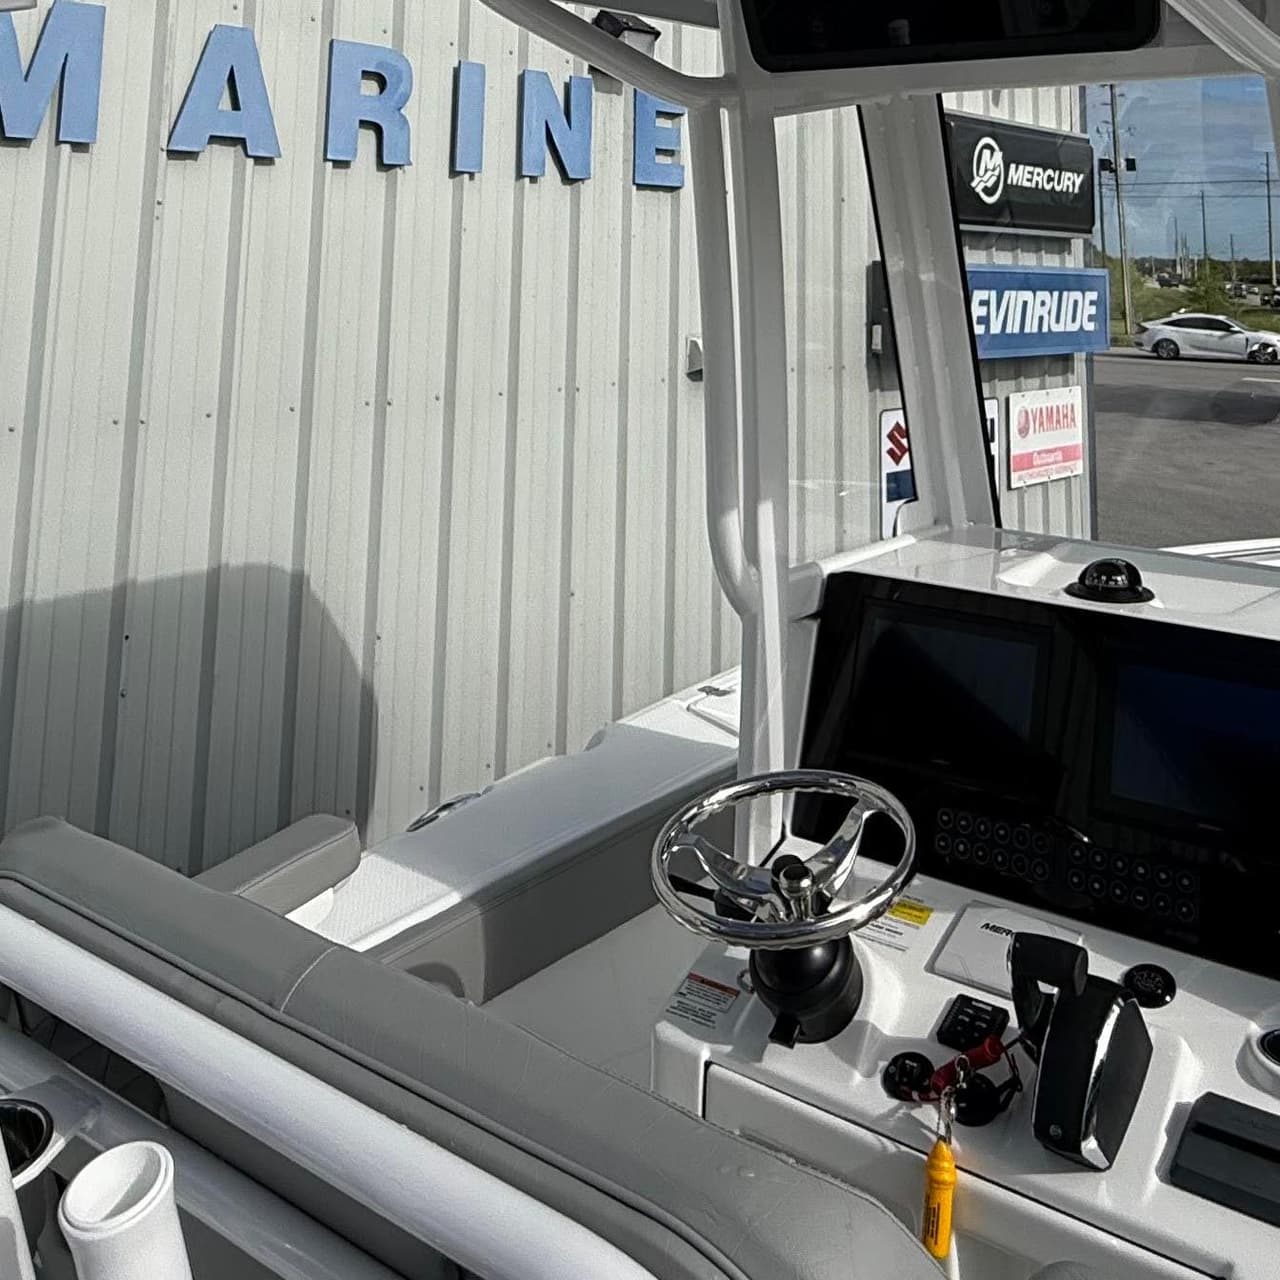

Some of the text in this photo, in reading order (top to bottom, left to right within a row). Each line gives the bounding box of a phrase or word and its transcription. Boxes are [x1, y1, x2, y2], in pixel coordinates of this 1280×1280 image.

[1007, 163, 1084, 194] MERCURY
[971, 289, 1098, 335] EVINRUDE
[1031, 403, 1076, 434] YAMAHA
[980, 922, 1012, 936] MER
